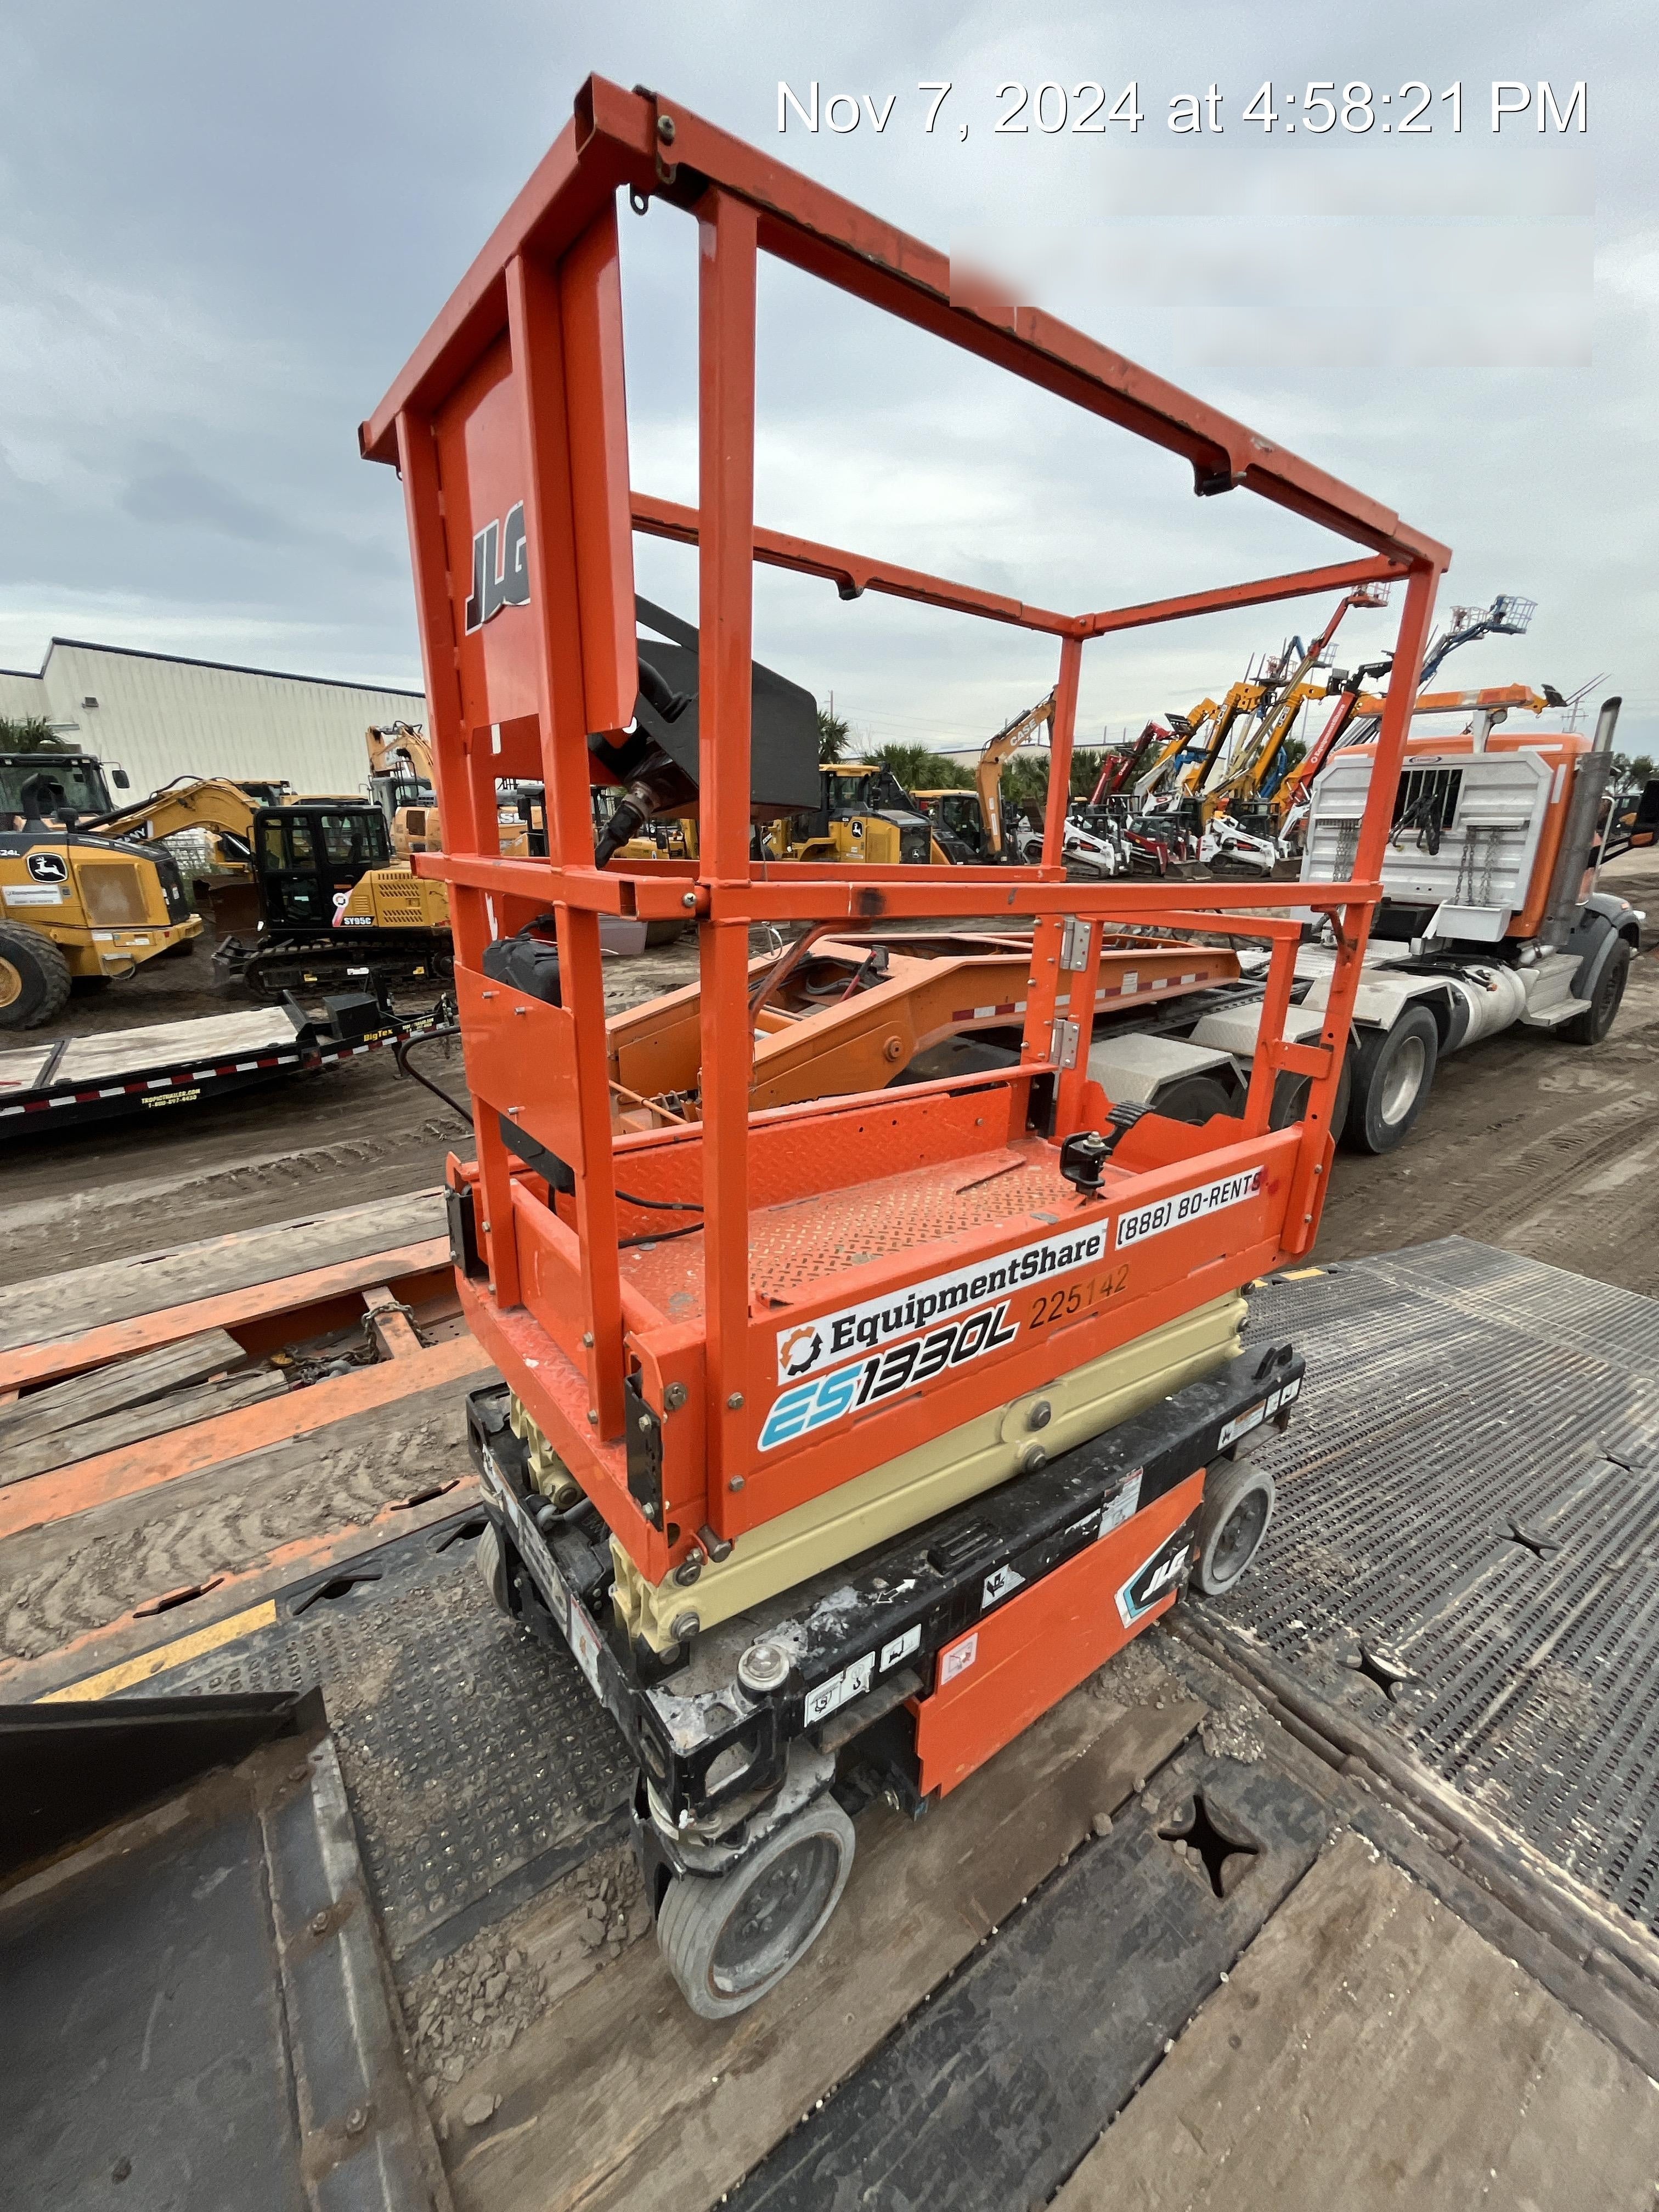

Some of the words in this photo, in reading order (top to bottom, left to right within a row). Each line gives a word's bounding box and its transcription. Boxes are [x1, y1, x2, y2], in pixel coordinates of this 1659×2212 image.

[465, 500, 531, 636] JLG
[1009, 718, 1037, 747] CASE
[1216, 704, 1228, 726] JCB
[1278, 706, 1290, 728] JCB
[1316, 704, 1345, 757] EquipmentShare
[343, 917, 371, 925] SY95C
[363, 1028, 393, 1042] BigTex
[831, 1235, 1100, 1353] EquipmentShare
[1118, 1203, 1172, 1245] (888)
[1178, 1171, 1261, 1219] 80-RENTS
[1029, 1263, 1129, 1330] 225142
[760, 1309, 1019, 1444] ES1330L
